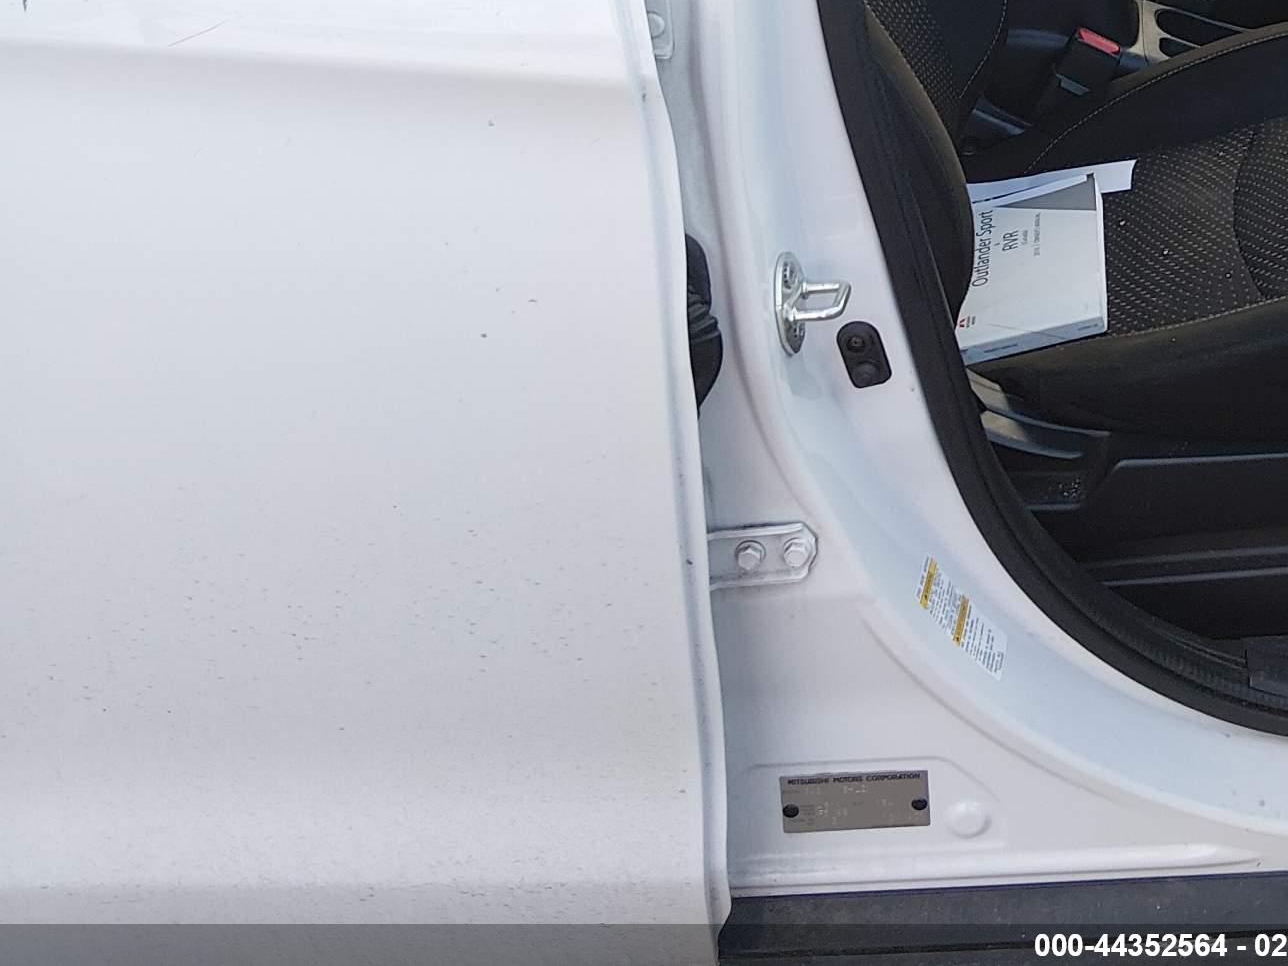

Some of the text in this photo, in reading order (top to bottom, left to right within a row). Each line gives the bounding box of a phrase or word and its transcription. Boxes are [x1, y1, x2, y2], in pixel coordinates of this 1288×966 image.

[971, 209, 996, 287] Outlander Sport
[1002, 230, 1019, 252] RVR
[833, 775, 863, 784] MOTORS
[866, 773, 921, 783] CORPORATION
